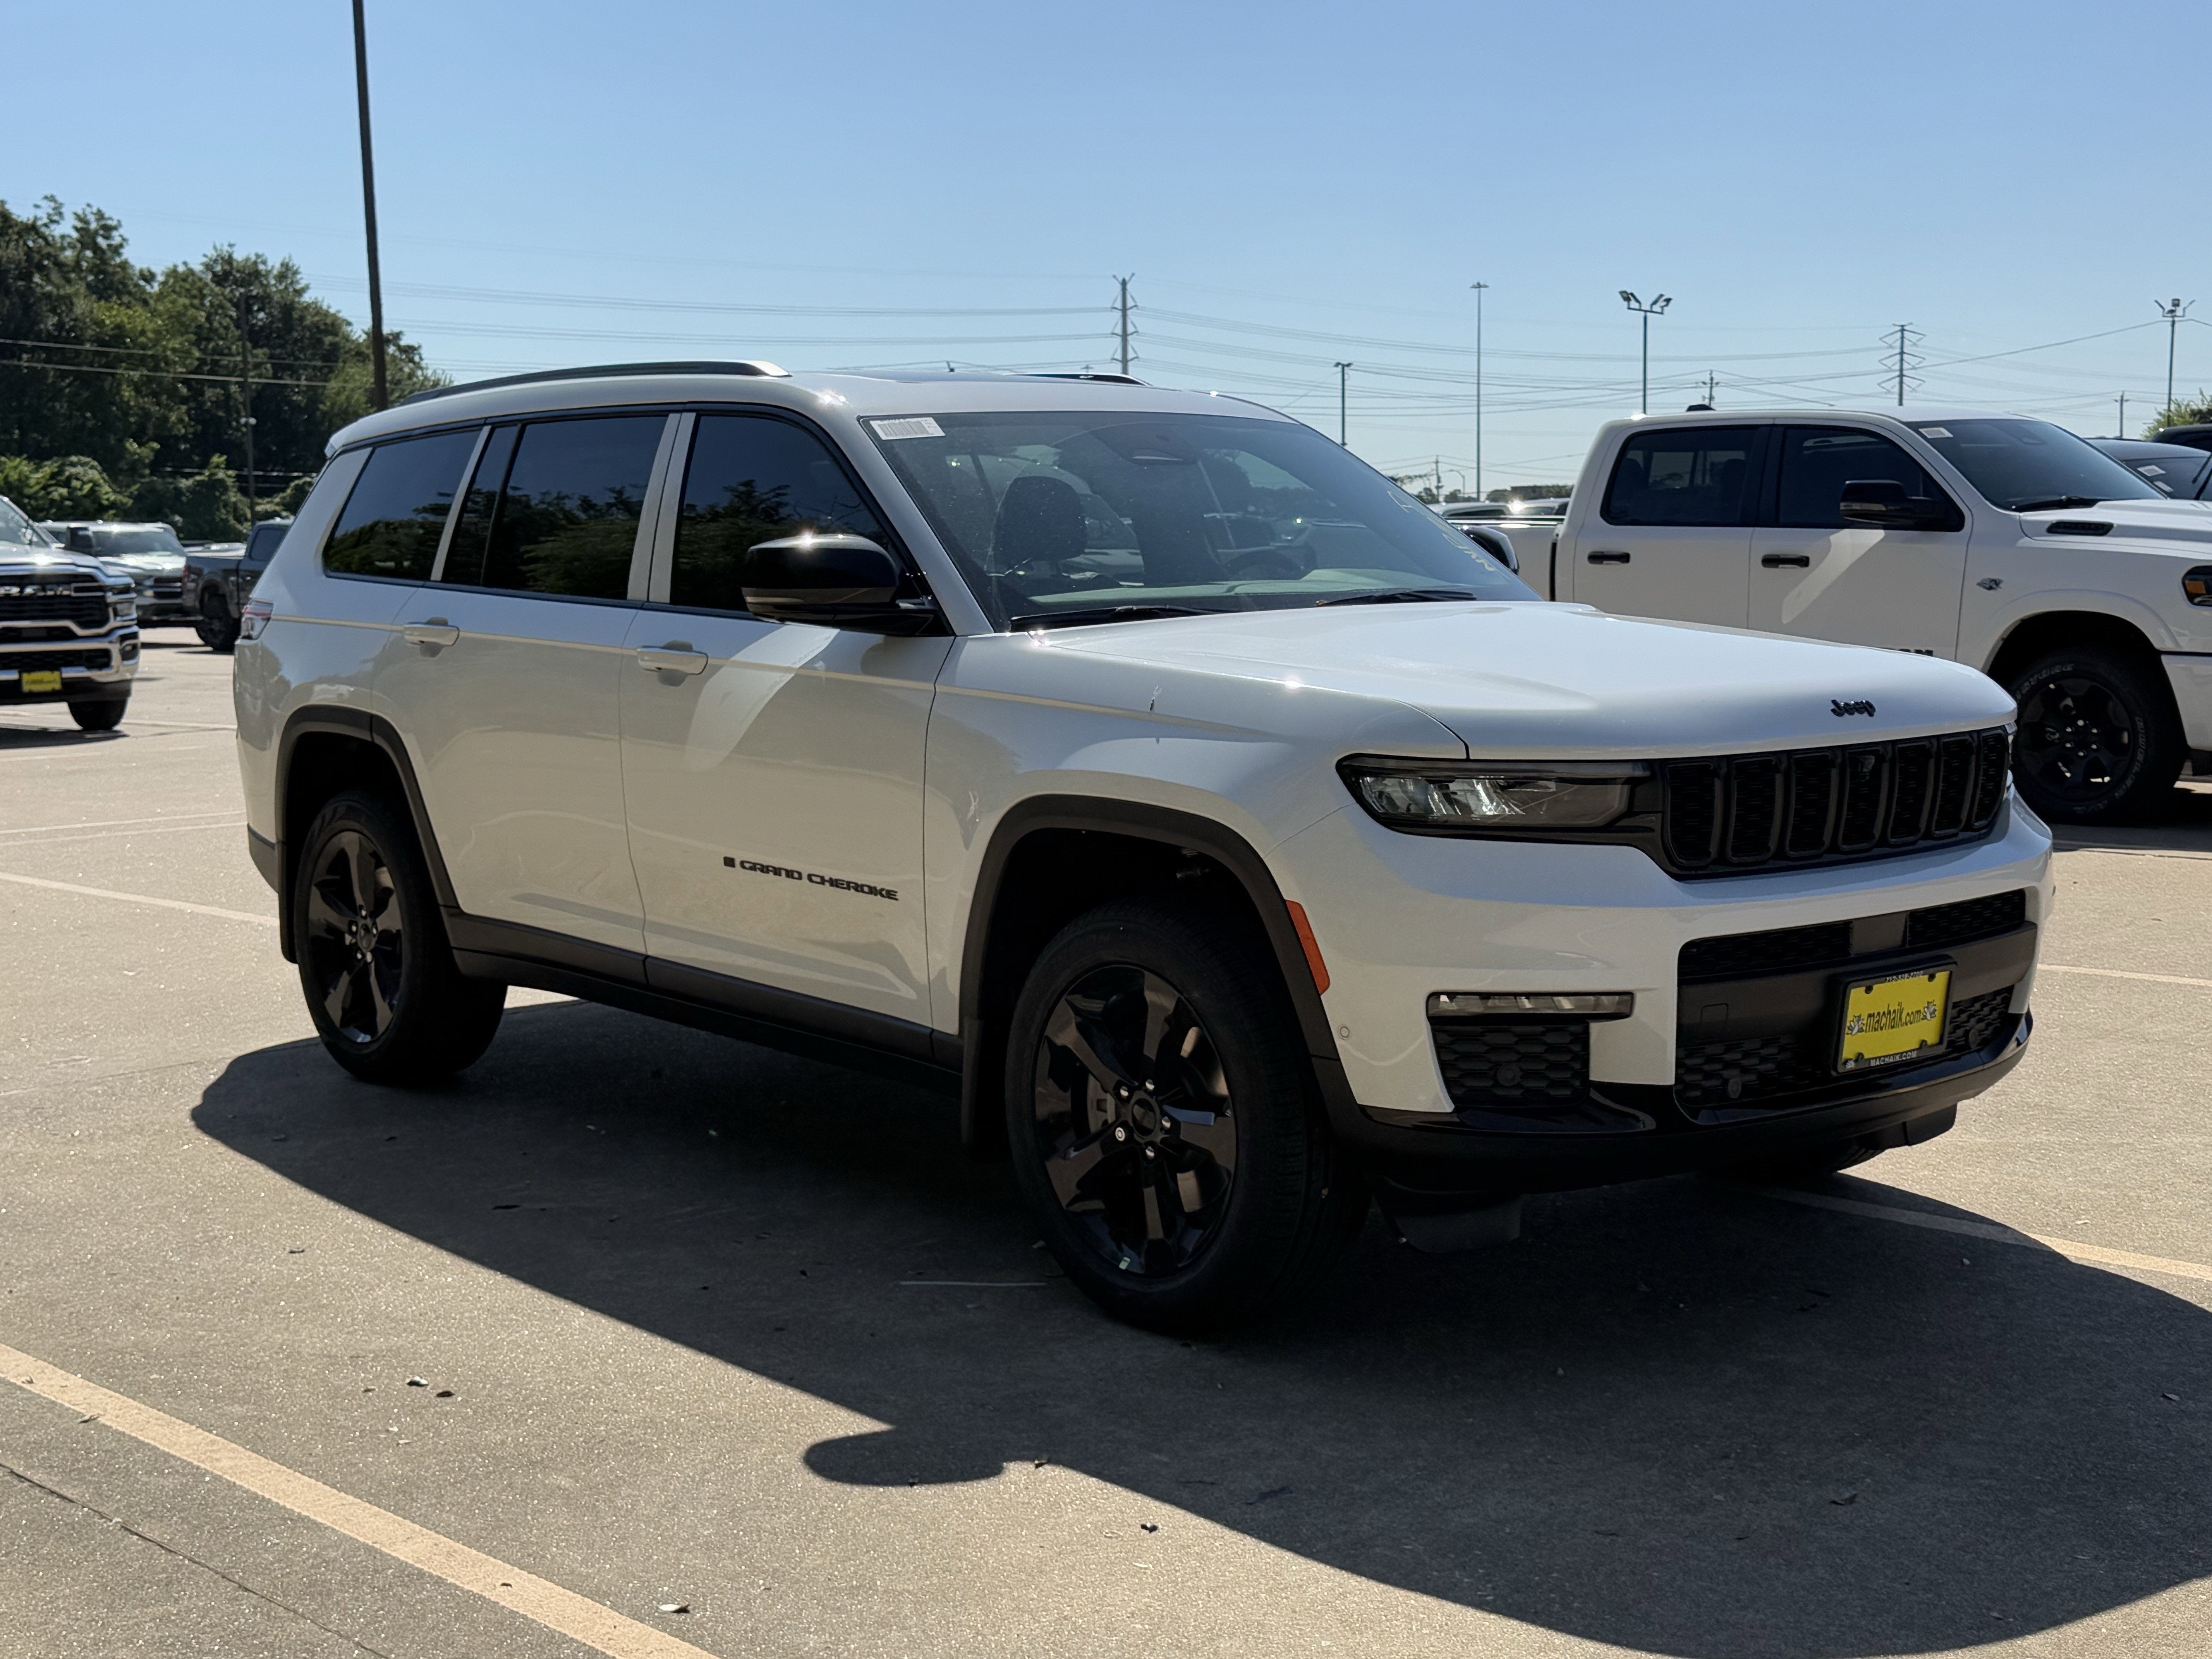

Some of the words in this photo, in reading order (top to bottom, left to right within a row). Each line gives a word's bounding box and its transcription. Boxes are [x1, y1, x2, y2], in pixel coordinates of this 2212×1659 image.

[1831, 699, 1876, 717] Jeep
[740, 860, 802, 880] GRAND
[1865, 1001, 1922, 1033] machaik.com
[1870, 1050, 1917, 1066] MACHAIK.COM
